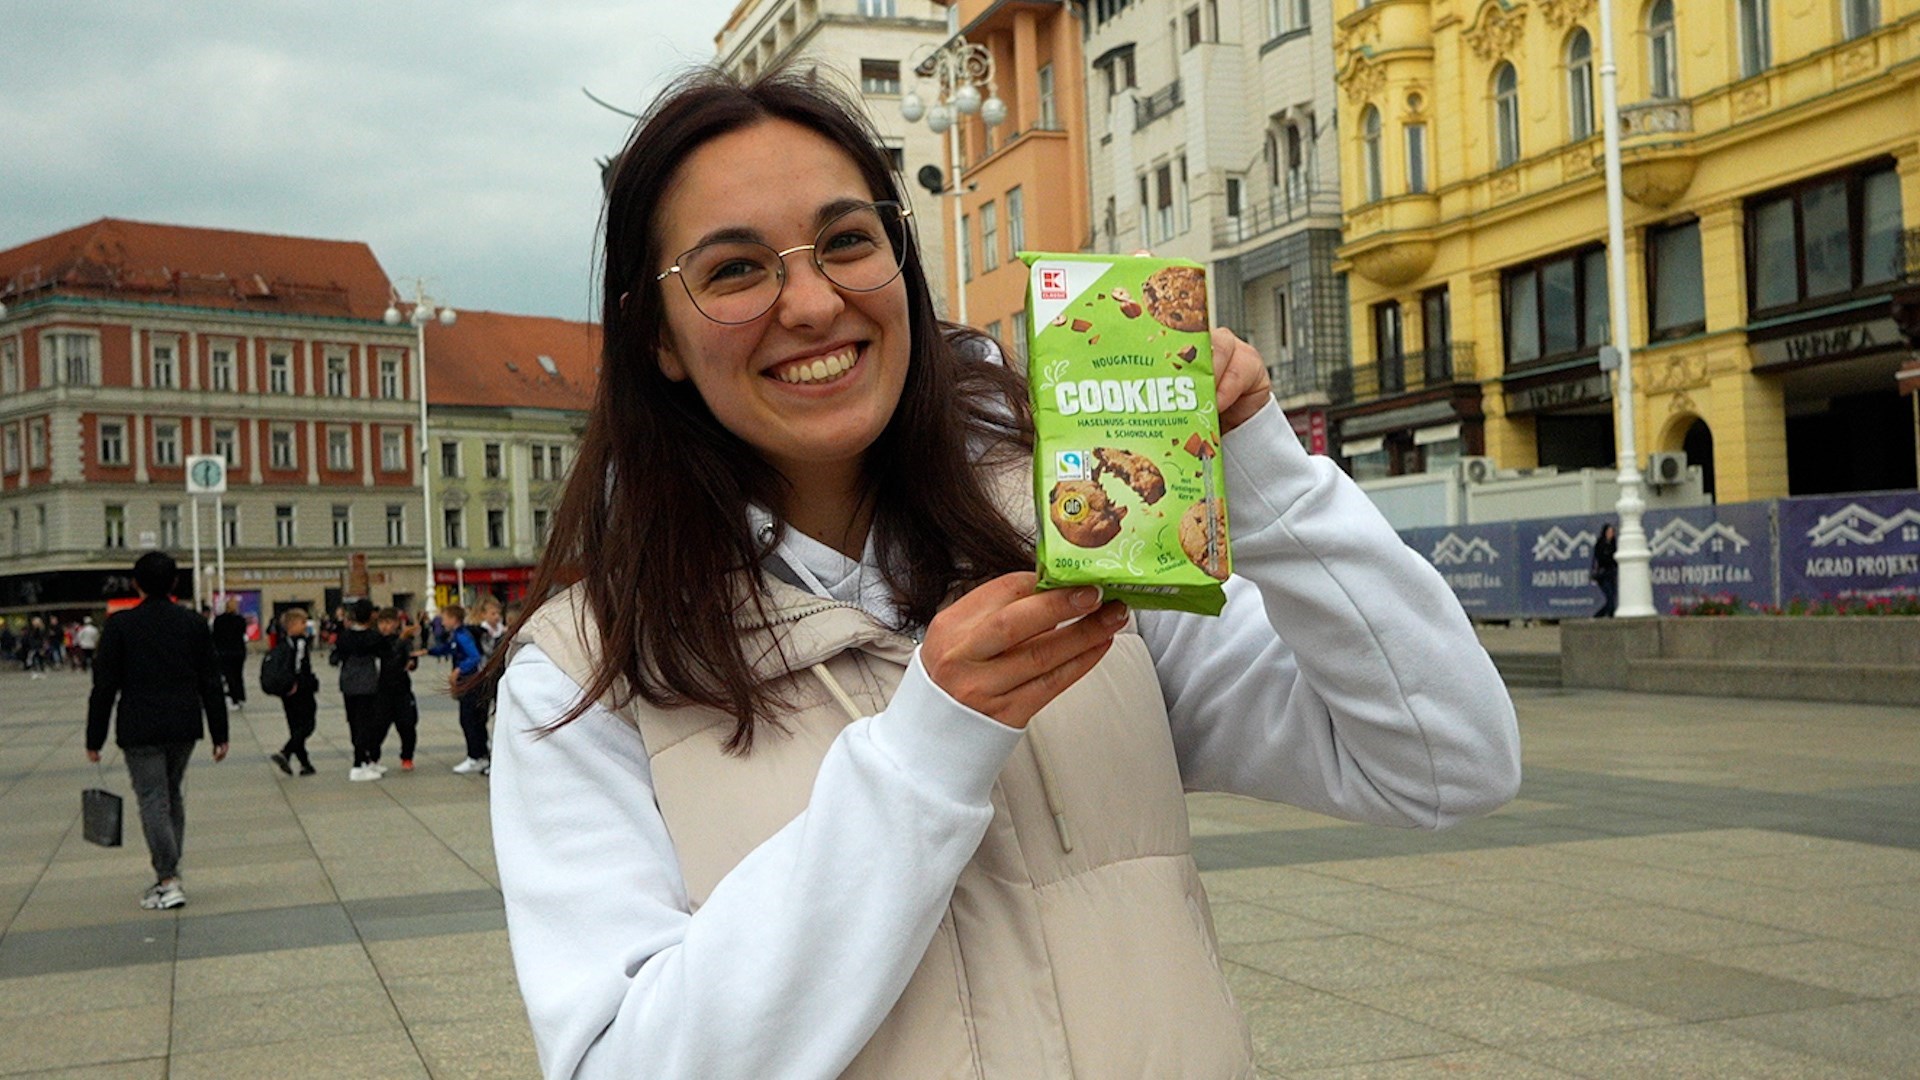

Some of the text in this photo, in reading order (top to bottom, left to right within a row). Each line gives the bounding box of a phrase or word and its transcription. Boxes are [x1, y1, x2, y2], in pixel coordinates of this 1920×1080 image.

[1092, 355, 1155, 369] NOUGATELLI
[1055, 376, 1198, 416] COOKIES
[1106, 430, 1164, 439] & SCHOKOLADE
[1055, 558, 1073, 568] 200
[1074, 560, 1080, 570] g
[1805, 553, 1919, 578] AGRAD PROJEKT
[1681, 564, 1725, 587] PROJEKT
